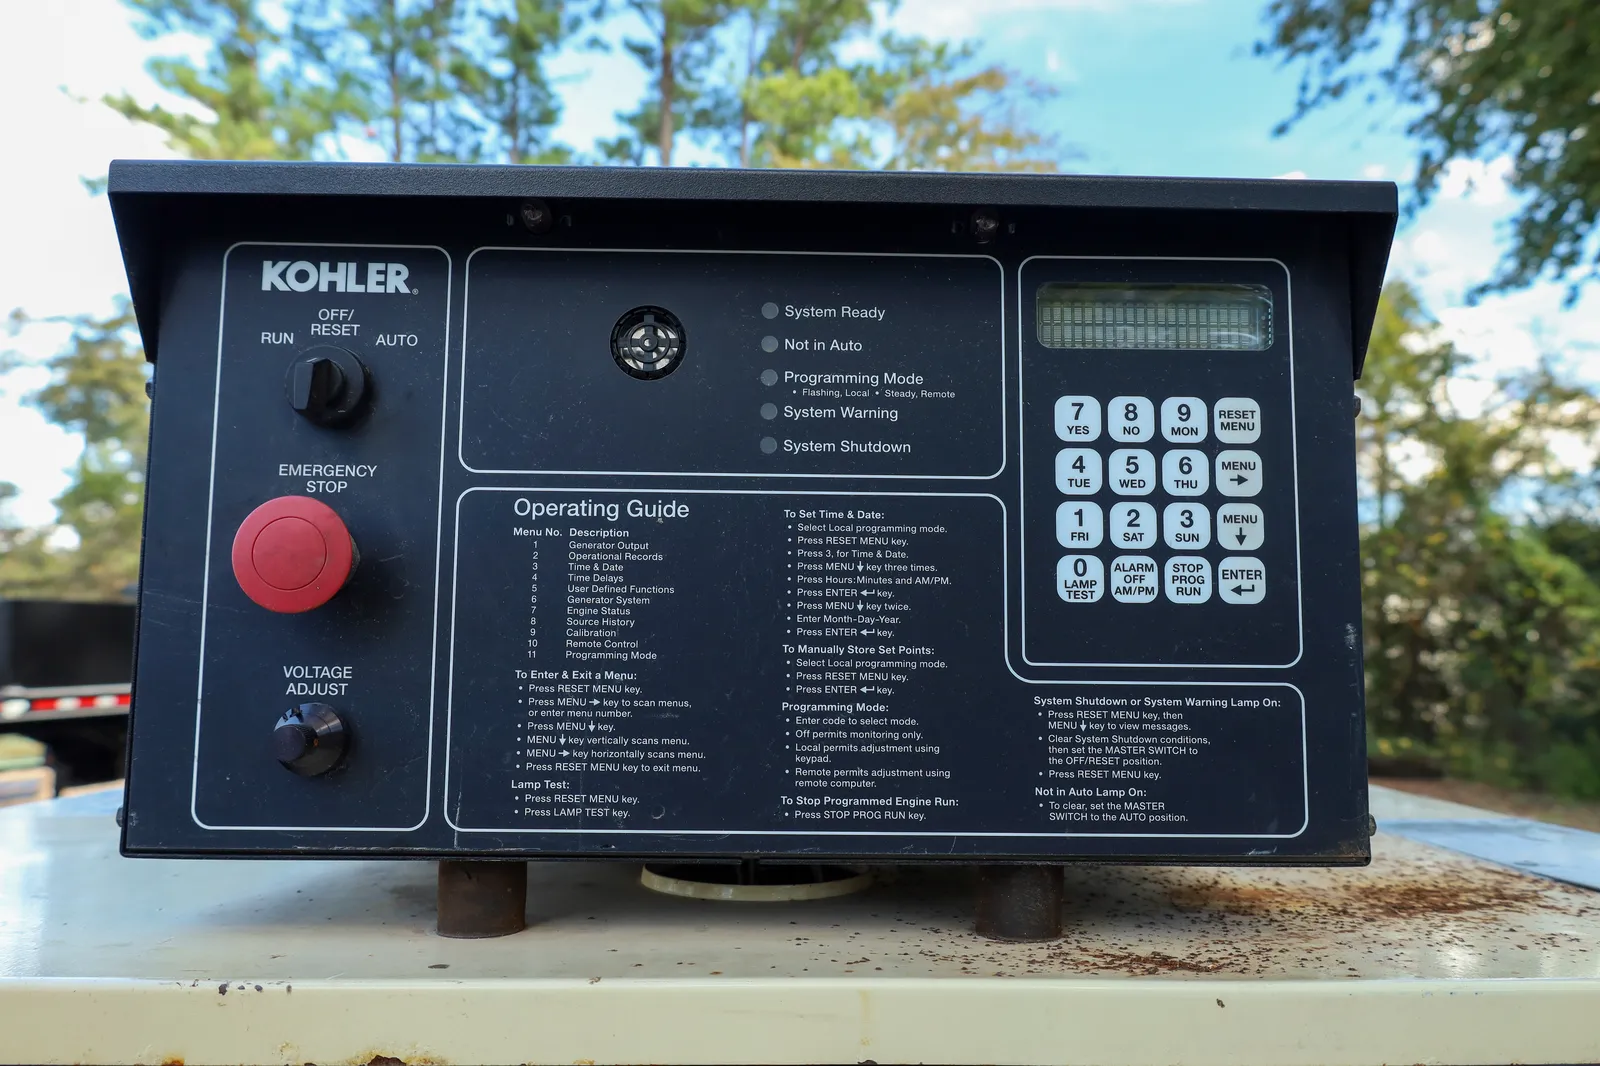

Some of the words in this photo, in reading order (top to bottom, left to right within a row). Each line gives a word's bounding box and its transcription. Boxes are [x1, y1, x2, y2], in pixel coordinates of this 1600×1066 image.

[261, 261, 413, 293] KOHLER
[318, 308, 354, 321] OFF/
[785, 305, 836, 320] System
[842, 306, 885, 321] Ready
[311, 323, 360, 336] RESET
[261, 332, 294, 344] RUN
[375, 334, 418, 346] AUTO
[785, 338, 809, 350] Not
[814, 339, 825, 350] in
[830, 339, 862, 351] Auto
[785, 371, 879, 387] Programming
[884, 372, 923, 385] Mode
[802, 388, 842, 398] Flashing,
[845, 389, 869, 397] Local
[884, 389, 918, 399] Steady,
[921, 390, 955, 398] Remote
[784, 405, 836, 420] System
[840, 406, 898, 422] Warning
[1071, 402, 1084, 420] 7
[1124, 403, 1138, 421] 8
[1177, 403, 1191, 422] 9
[1219, 410, 1256, 419] RESET
[1067, 425, 1090, 435] YES
[1123, 426, 1140, 435] NO
[1171, 427, 1198, 436] MON
[1220, 422, 1255, 431] MENU
[783, 439, 835, 454] System
[840, 440, 911, 453] Shutdown
[1072, 455, 1086, 473] 4
[1125, 456, 1139, 474] 5
[1179, 456, 1192, 475] 6
[1222, 461, 1256, 471] MENU
[279, 464, 377, 477] EMERGENCY
[306, 480, 348, 493] STOP
[1067, 478, 1090, 488] TUE
[1119, 479, 1146, 488] WED
[1174, 480, 1198, 489] THU
[514, 498, 619, 521] Operating
[627, 499, 689, 518] Guide
[784, 509, 796, 518] To
[799, 509, 816, 518] Set
[819, 510, 844, 519] Time
[847, 510, 854, 519] &
[857, 510, 884, 519] Date:
[1074, 508, 1083, 527] 1
[1127, 509, 1140, 527] 2
[1180, 509, 1194, 528] 3
[1223, 514, 1258, 524] MENU
[513, 527, 542, 536] Menu
[545, 528, 562, 536] No.
[569, 528, 629, 539] Description
[1071, 532, 1089, 541] FRI
[1123, 532, 1144, 542] SAT
[1175, 533, 1199, 542] SUN
[569, 541, 615, 549] Generator
[617, 541, 649, 551] Output
[533, 551, 538, 559] 2
[568, 551, 622, 561] Operational
[625, 552, 663, 561] Records
[532, 562, 538, 570] 3
[568, 562, 591, 571] Time
[593, 563, 599, 571] &
[602, 563, 624, 571] Date
[1073, 558, 1087, 577] 0
[1114, 563, 1154, 572] ALARM
[1173, 563, 1203, 573] STOP
[532, 573, 537, 581] 4
[568, 573, 590, 582] Time
[593, 574, 624, 584] Delays
[797, 575, 823, 583] Press
[825, 576, 893, 584] Hours:Minutes
[915, 577, 951, 585] AM/PM.
[1124, 574, 1145, 584] OFF
[1172, 575, 1205, 585] PROG
[1222, 569, 1262, 580] ENTER
[532, 584, 537, 592] 5
[568, 584, 589, 593] User
[592, 585, 627, 593] Defined
[630, 585, 675, 594] Functions
[1064, 580, 1097, 589] LAMP
[1066, 590, 1095, 600] TEST
[1114, 587, 1155, 596] AM/PM
[1176, 587, 1201, 596] RUN
[531, 595, 537, 603] 6
[567, 595, 614, 604] Generator
[616, 596, 650, 606] System
[531, 606, 537, 614] 7
[567, 606, 598, 617] Engine
[601, 606, 630, 615] Status
[530, 617, 536, 625] 8
[566, 617, 599, 626] Source
[602, 618, 635, 628] History
[797, 614, 821, 623] Enter
[823, 615, 901, 625] Month-Day-Year.
[530, 628, 536, 636] 9
[566, 628, 616, 637] Calibration
[528, 639, 538, 647] 10
[566, 639, 602, 648] Remote
[604, 640, 638, 648] Control
[528, 650, 536, 658] 11
[566, 650, 628, 661] Programming
[631, 651, 657, 660] Mode
[782, 644, 795, 653] To
[798, 645, 845, 656] Manually
[847, 645, 875, 654] Store
[878, 645, 895, 654] Set
[899, 646, 934, 655] Points:
[283, 666, 352, 679] VOLTAGE
[515, 670, 527, 679] To
[531, 670, 559, 679] Enter
[561, 670, 569, 679] &
[572, 670, 592, 679] Exit
[604, 671, 637, 681] Menu:
[286, 683, 348, 696] ADJUST
[782, 702, 853, 714] Programming
[856, 703, 888, 712] Mode:
[1034, 696, 1072, 707] System
[1075, 696, 1127, 705] Shutdown
[1144, 697, 1182, 708] System
[1185, 697, 1228, 709] Warning
[1231, 698, 1260, 708] Lamp
[1263, 698, 1281, 707] On:
[540, 709, 565, 717] enter
[595, 709, 632, 718] number.
[1048, 734, 1073, 743] Clear
[1075, 734, 1109, 745] System
[1111, 735, 1157, 743] Shutdown
[1160, 736, 1210, 745] conditions,
[795, 743, 820, 752] Local
[823, 744, 858, 753] permits
[861, 744, 912, 754] adjustment
[915, 744, 940, 754] using
[511, 780, 541, 791] Lamp
[544, 780, 569, 789] Test:
[1035, 787, 1053, 796] Not
[1056, 787, 1065, 796] in
[1068, 787, 1093, 796] Auto
[1096, 788, 1125, 798] Lamp
[1128, 788, 1146, 797] On:
[781, 796, 793, 805] To
[796, 796, 821, 807] Stop
[824, 796, 892, 807] Programmed
[896, 797, 931, 808] Engine
[935, 797, 958, 806] Run:
